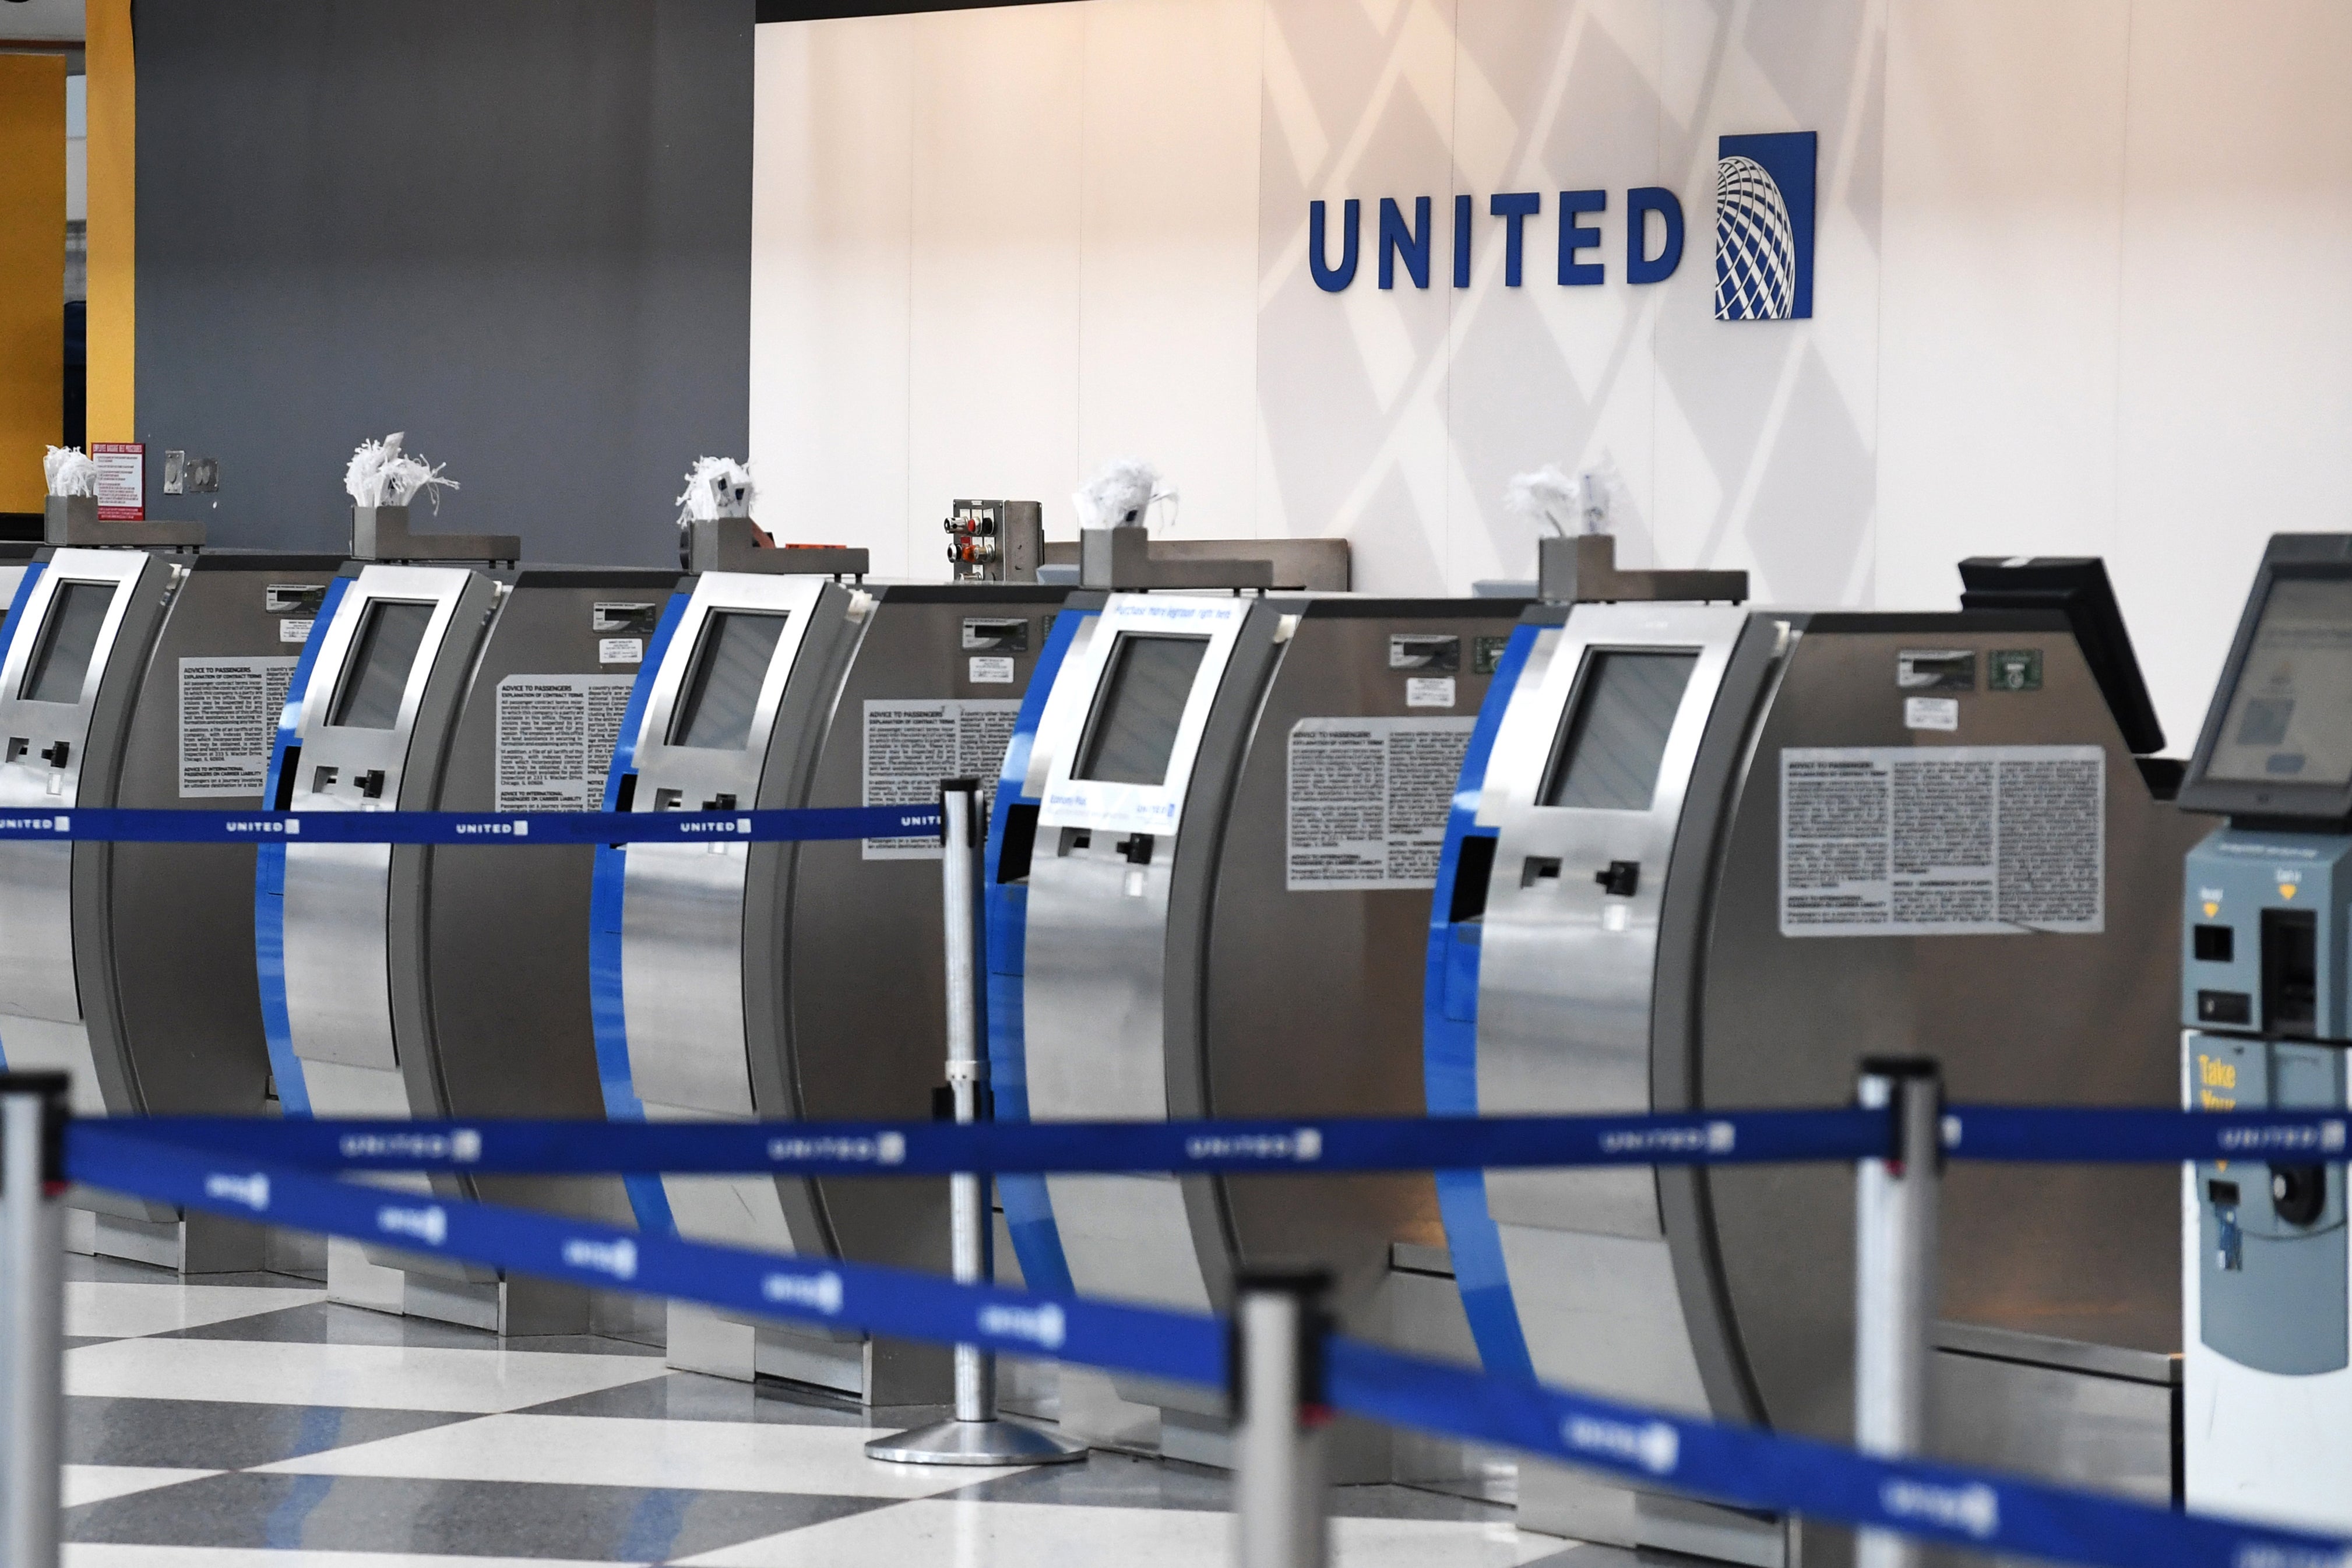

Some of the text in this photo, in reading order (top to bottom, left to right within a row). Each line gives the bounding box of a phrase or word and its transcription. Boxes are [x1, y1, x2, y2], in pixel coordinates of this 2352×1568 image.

[1308, 186, 1685, 293] UNITED
[226, 822, 283, 831] UNITED
[456, 823, 512, 834] UNITED
[680, 822, 735, 832] UNITED
[2199, 1054, 2236, 1089] Take
